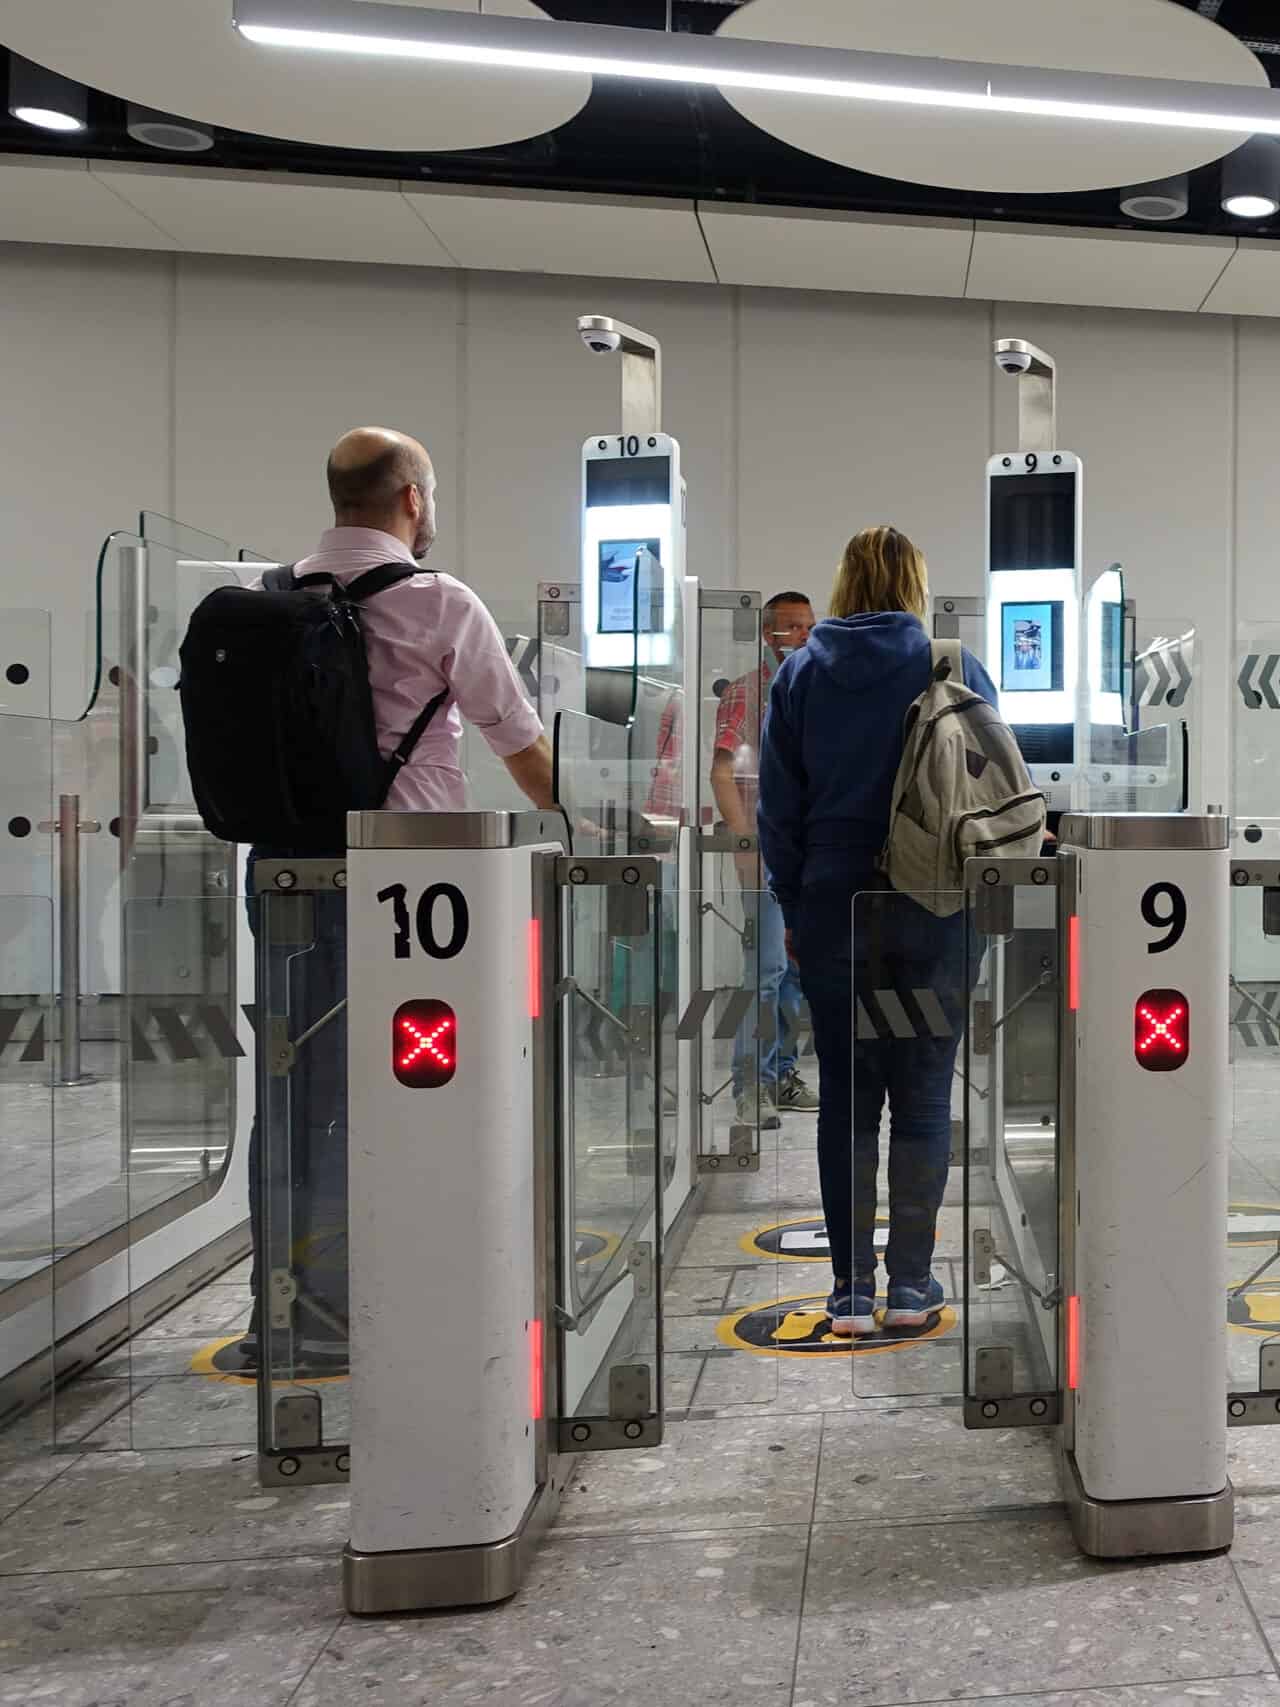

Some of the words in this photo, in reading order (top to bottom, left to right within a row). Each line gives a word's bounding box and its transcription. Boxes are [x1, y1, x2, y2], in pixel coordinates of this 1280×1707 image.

[616, 435, 640, 457] 10
[1024, 453, 1038, 473] 9
[376, 882, 470, 960] 10
[1140, 881, 1187, 955] 9
